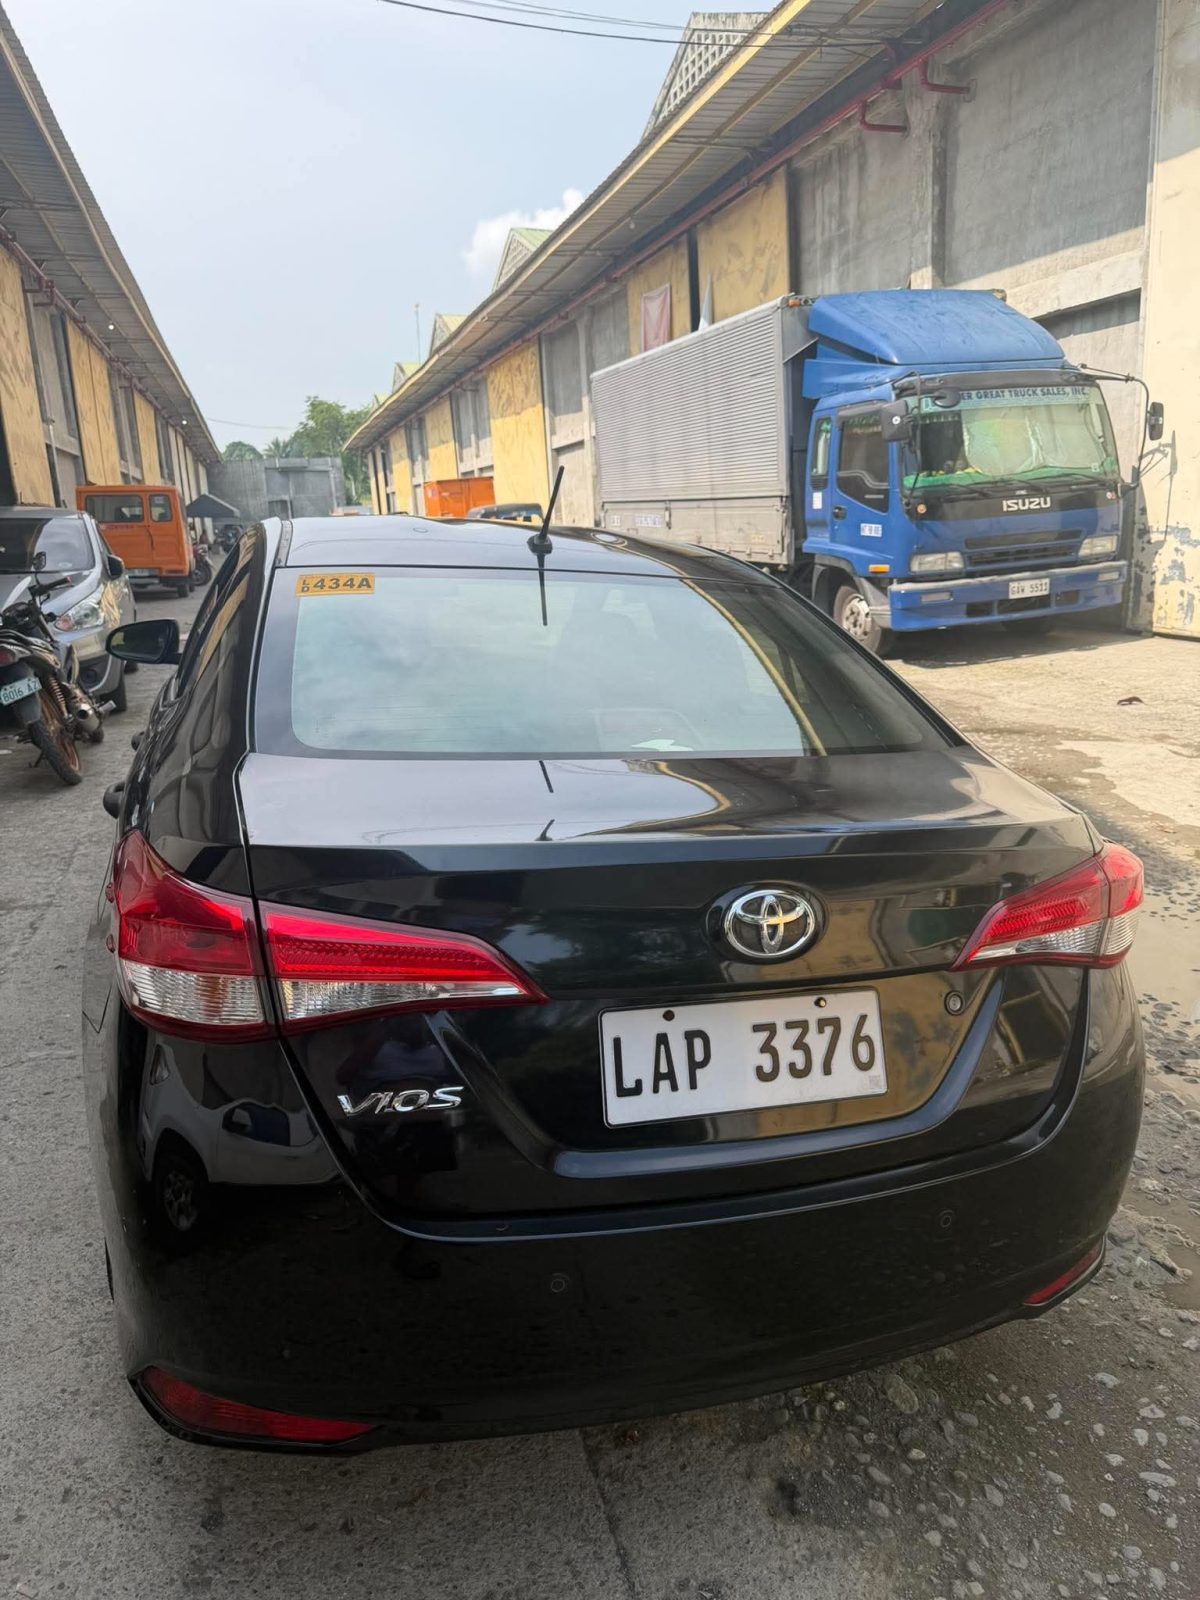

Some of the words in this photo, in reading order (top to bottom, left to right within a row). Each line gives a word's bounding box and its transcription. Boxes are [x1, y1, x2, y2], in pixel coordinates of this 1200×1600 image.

[976, 389, 1006, 400] GREAT
[1008, 388, 1038, 399] TRUCK
[1041, 387, 1069, 397] SALES,
[1002, 497, 1051, 512] ISUZU
[313, 577, 372, 589] 434A
[612, 1029, 712, 1098] LAP
[752, 1014, 876, 1082] 3376
[337, 1086, 464, 1117] VIOS
